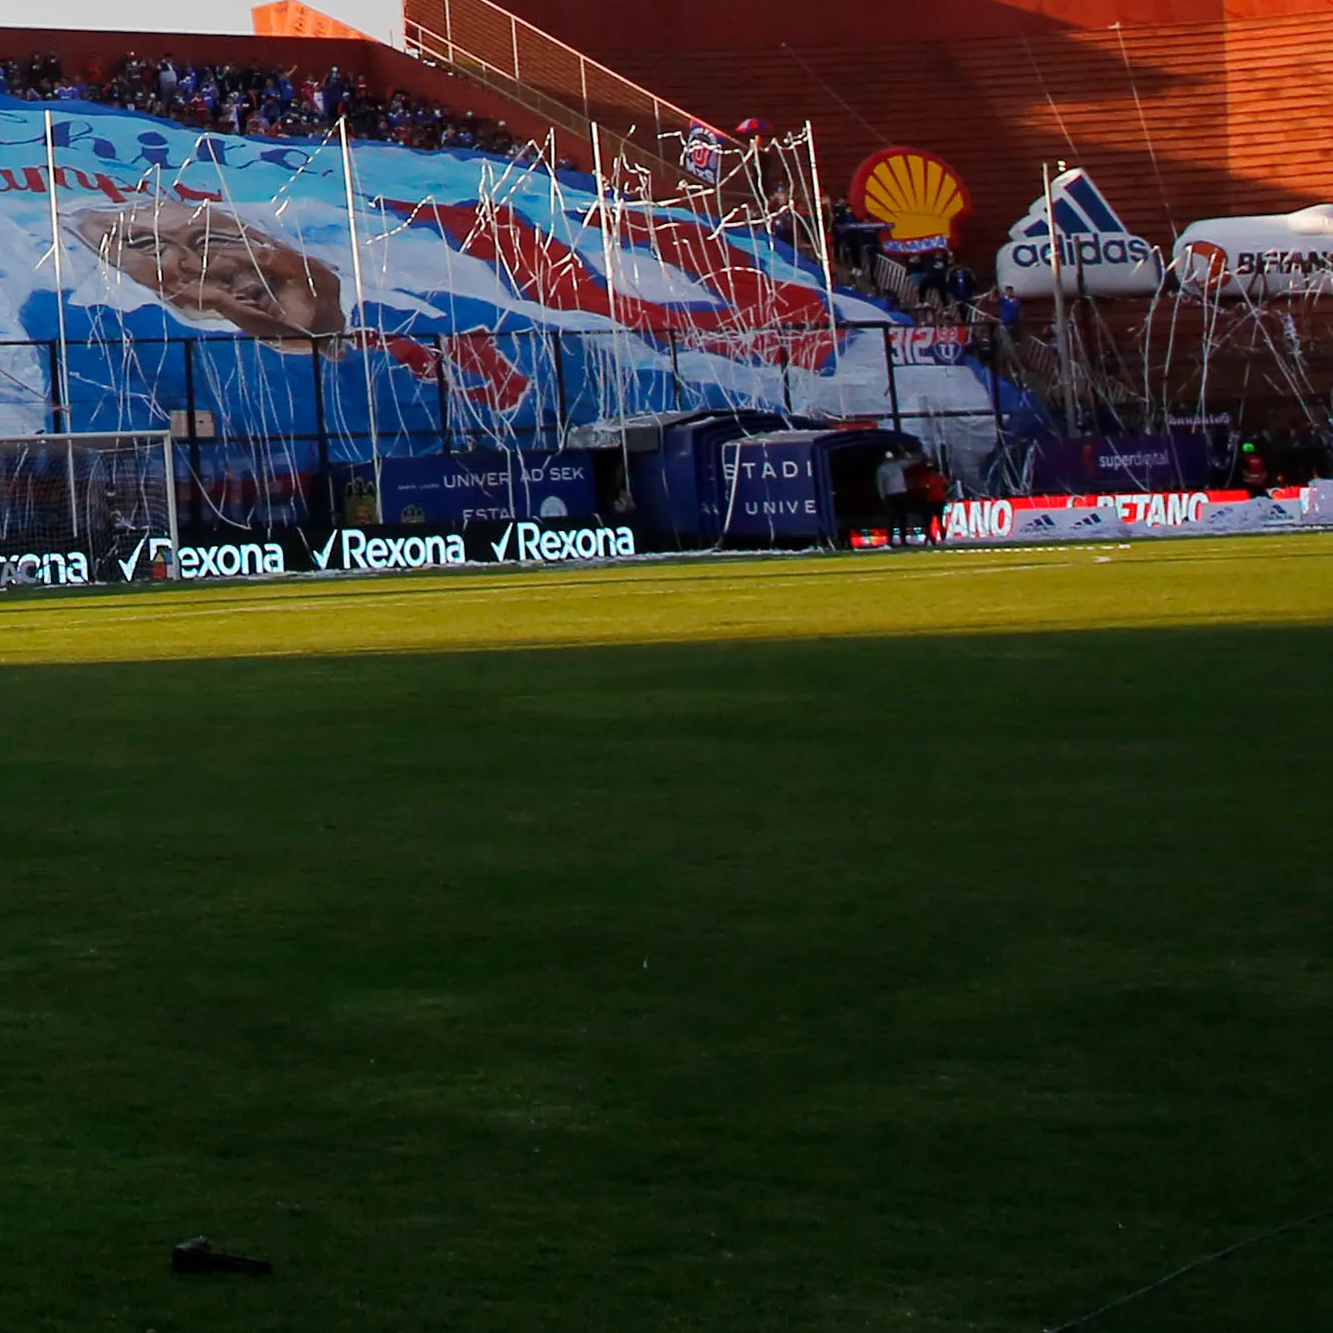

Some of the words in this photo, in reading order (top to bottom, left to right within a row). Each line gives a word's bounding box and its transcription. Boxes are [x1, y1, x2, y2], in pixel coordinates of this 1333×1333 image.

[1013, 233, 1150, 267] adidas
[549, 466, 584, 481] SEK
[1098, 449, 1169, 470] superdigital
[342, 528, 466, 568] Rexona
[517, 521, 635, 562] Rexona
